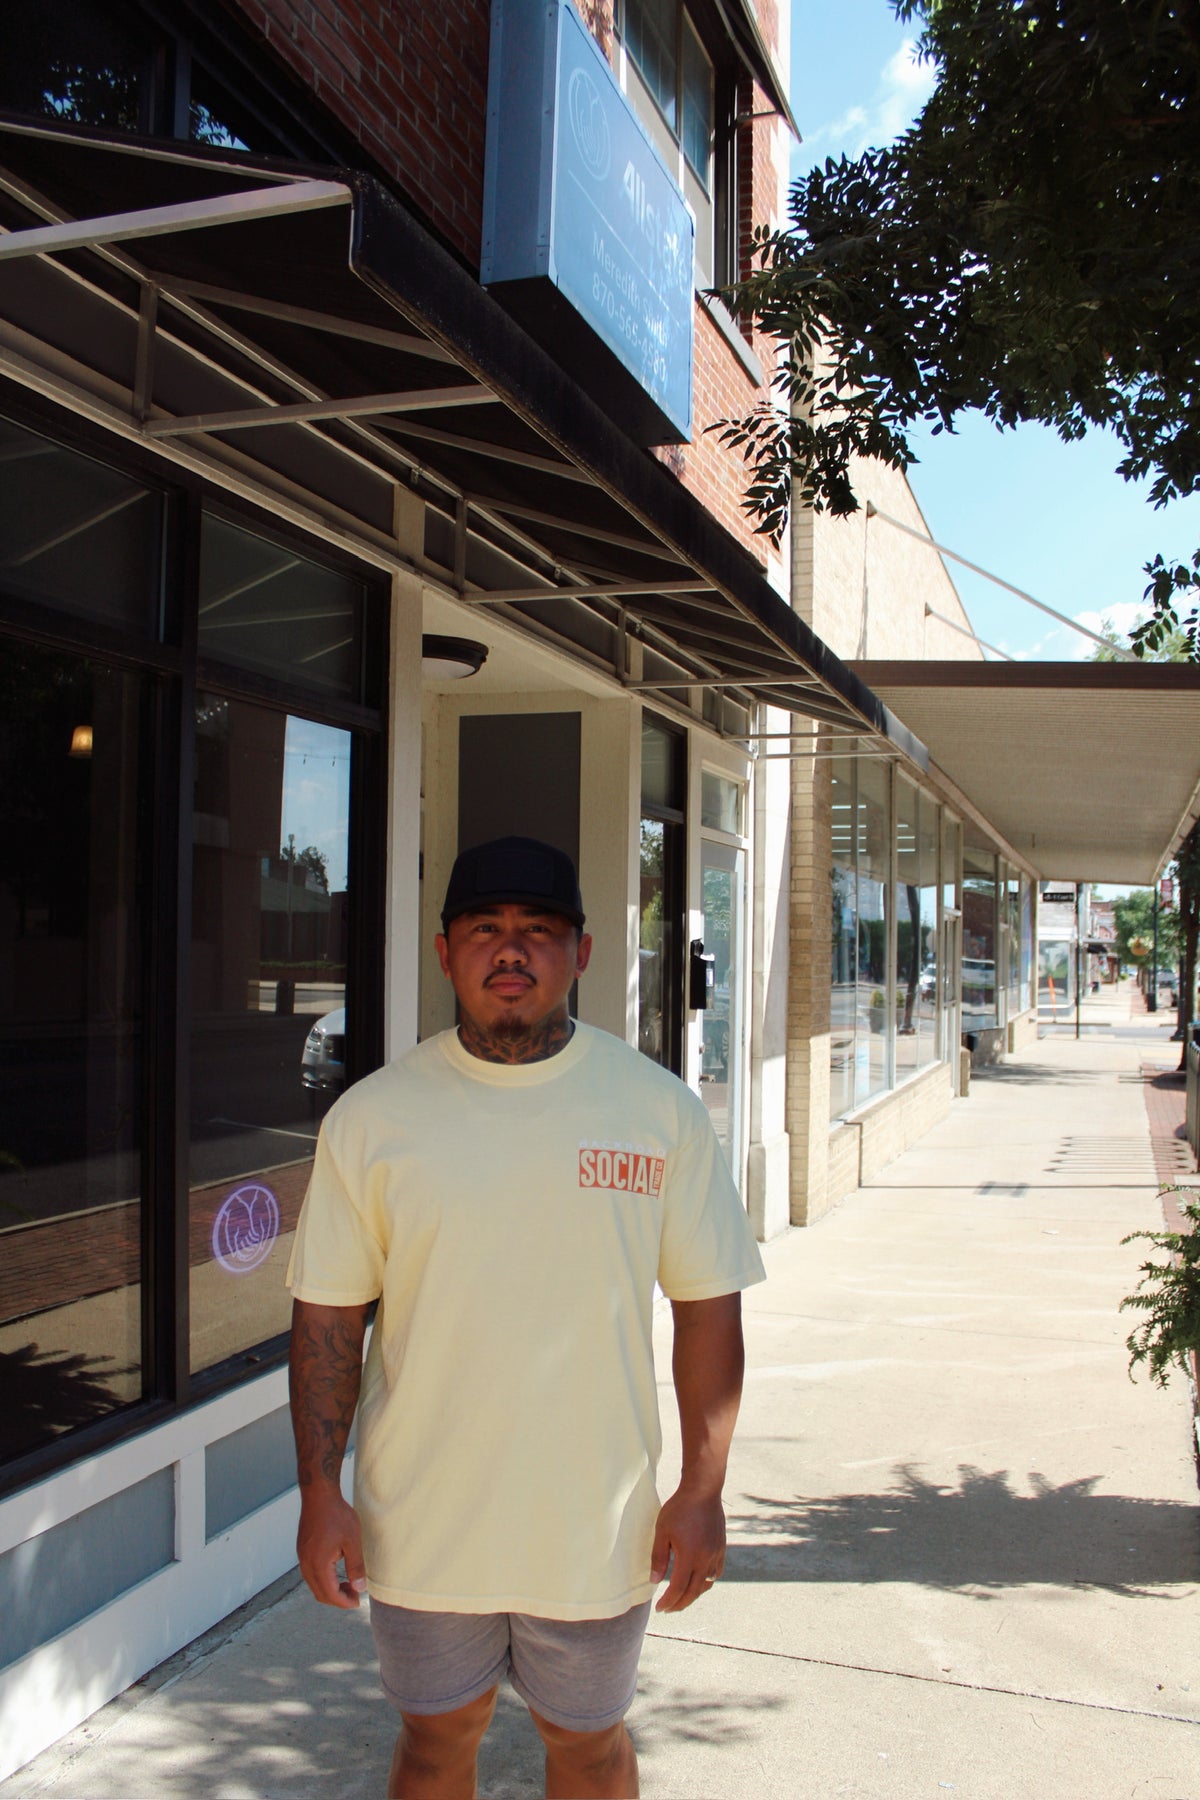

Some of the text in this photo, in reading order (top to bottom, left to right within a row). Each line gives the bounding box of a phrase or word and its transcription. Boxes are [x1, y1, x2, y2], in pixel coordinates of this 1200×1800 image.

[622, 160, 688, 296] Allstate
[593, 231, 668, 348] Meredith Smith
[580, 1150, 658, 1195] SOCIAL
